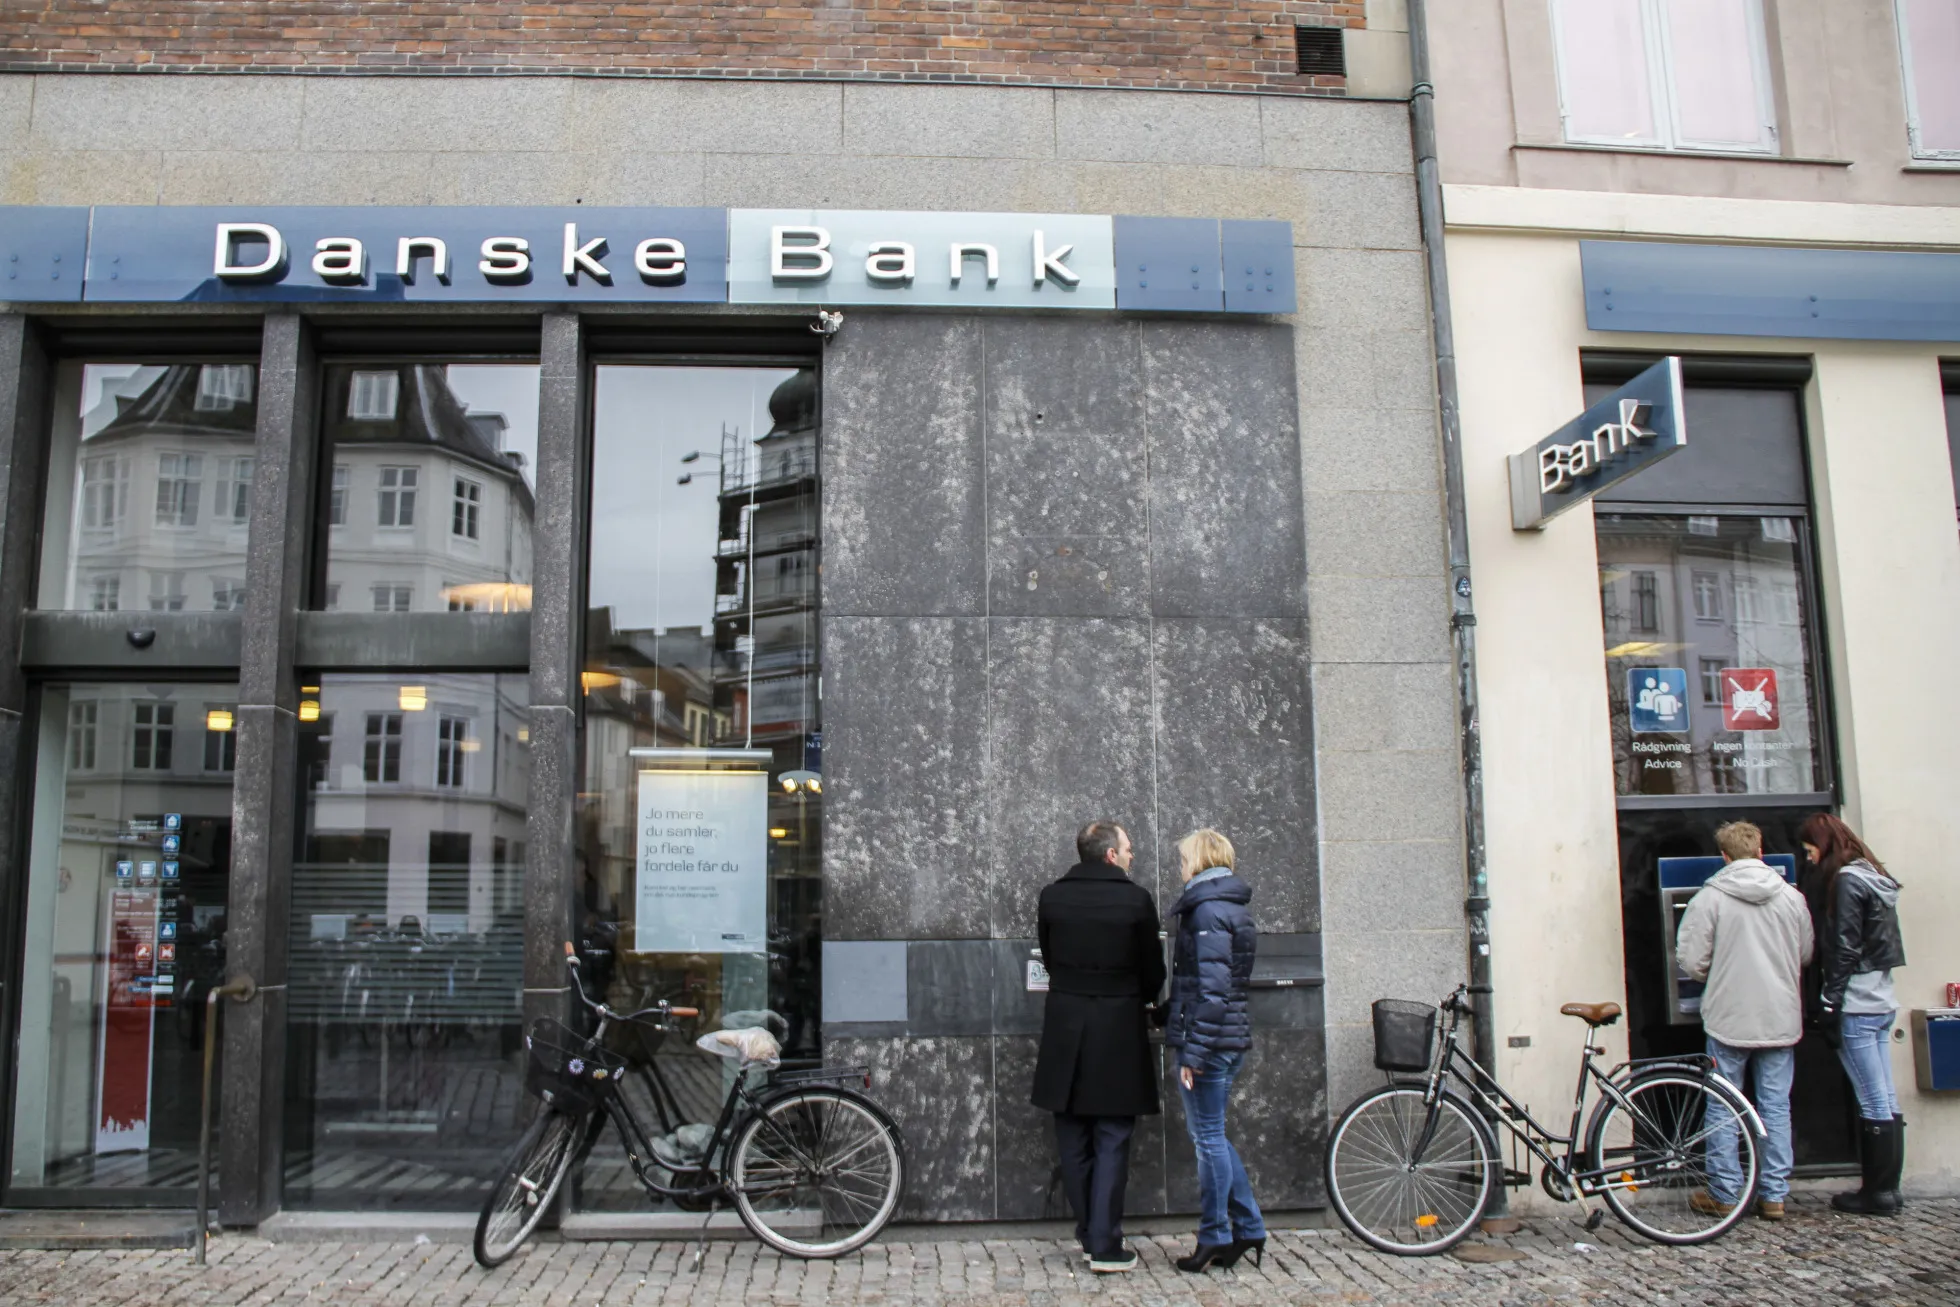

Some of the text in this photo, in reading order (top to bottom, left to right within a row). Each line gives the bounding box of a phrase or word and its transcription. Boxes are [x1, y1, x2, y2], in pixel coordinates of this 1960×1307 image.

[213, 222, 1081, 287] Danske Bank
[1539, 399, 1657, 494] Bank
[1632, 741, 1692, 753] Rådgivning
[1713, 741, 1794, 753] Ingen ontanter
[1644, 758, 1682, 768] Advice
[1732, 757, 1749, 768] No
[645, 808, 704, 820] Jo mere
[645, 826, 662, 837] du
[644, 842, 695, 857] jo flere
[644, 859, 739, 872] fordele får du
